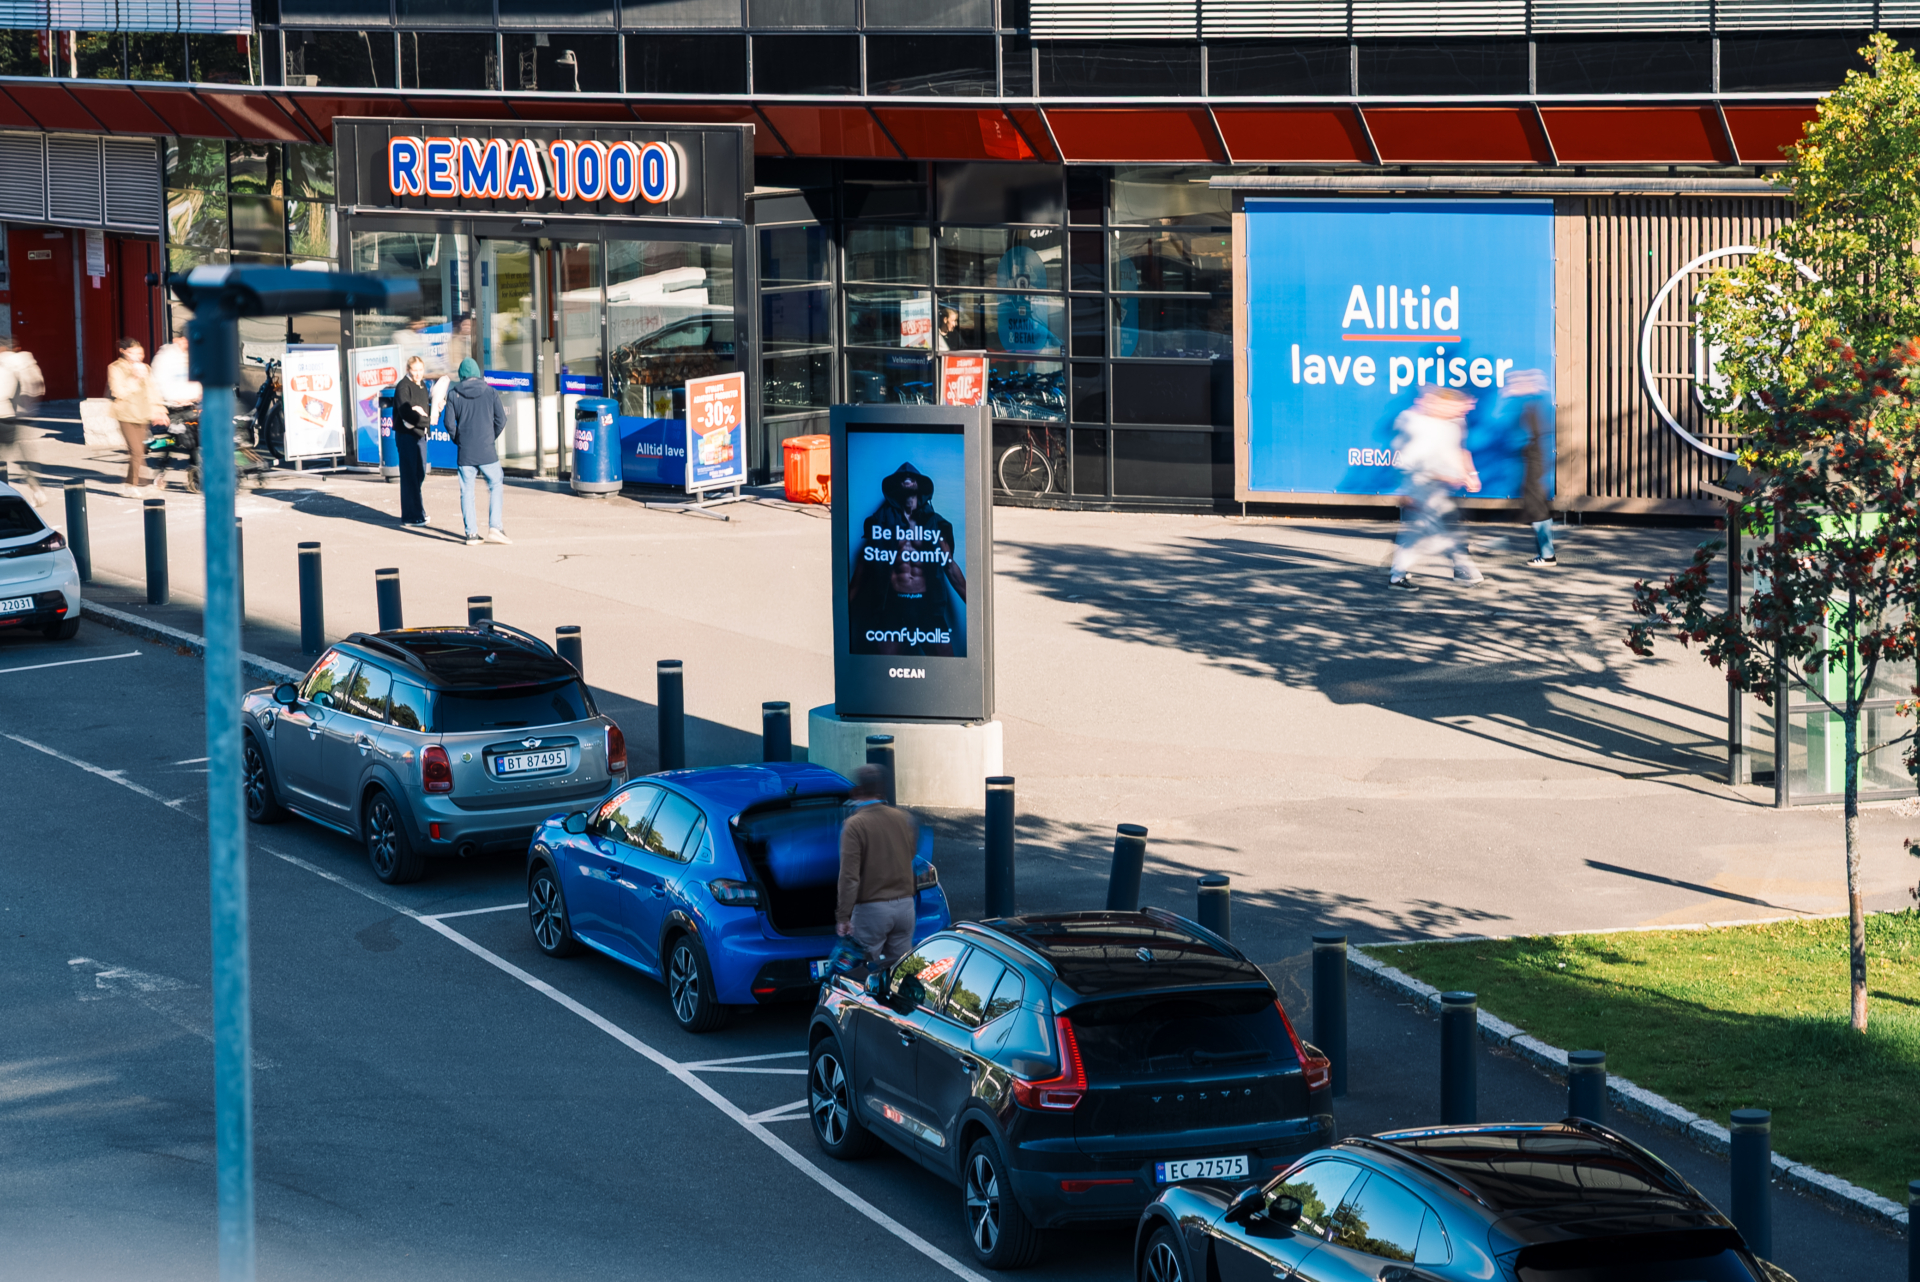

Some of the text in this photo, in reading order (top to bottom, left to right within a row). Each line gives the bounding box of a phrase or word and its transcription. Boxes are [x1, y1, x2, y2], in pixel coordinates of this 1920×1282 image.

[388, 136, 676, 204] REMA 1000
[1341, 284, 1460, 331] Alltid
[1290, 343, 1514, 395] lave priser
[697, 400, 736, 428] -30%
[636, 442, 685, 458] Alltid lave
[1348, 448, 1404, 466] REMA
[872, 525, 944, 545] Be ballsy.
[864, 546, 952, 567] Stay comfy.
[2, 598, 31, 611] 22031
[865, 627, 952, 647] comfyballs
[888, 667, 926, 679] OCEAN
[508, 757, 522, 770] BT
[527, 752, 563, 768] 87495
[1171, 1163, 1189, 1180] EC
[1196, 1158, 1243, 1177] 27575
